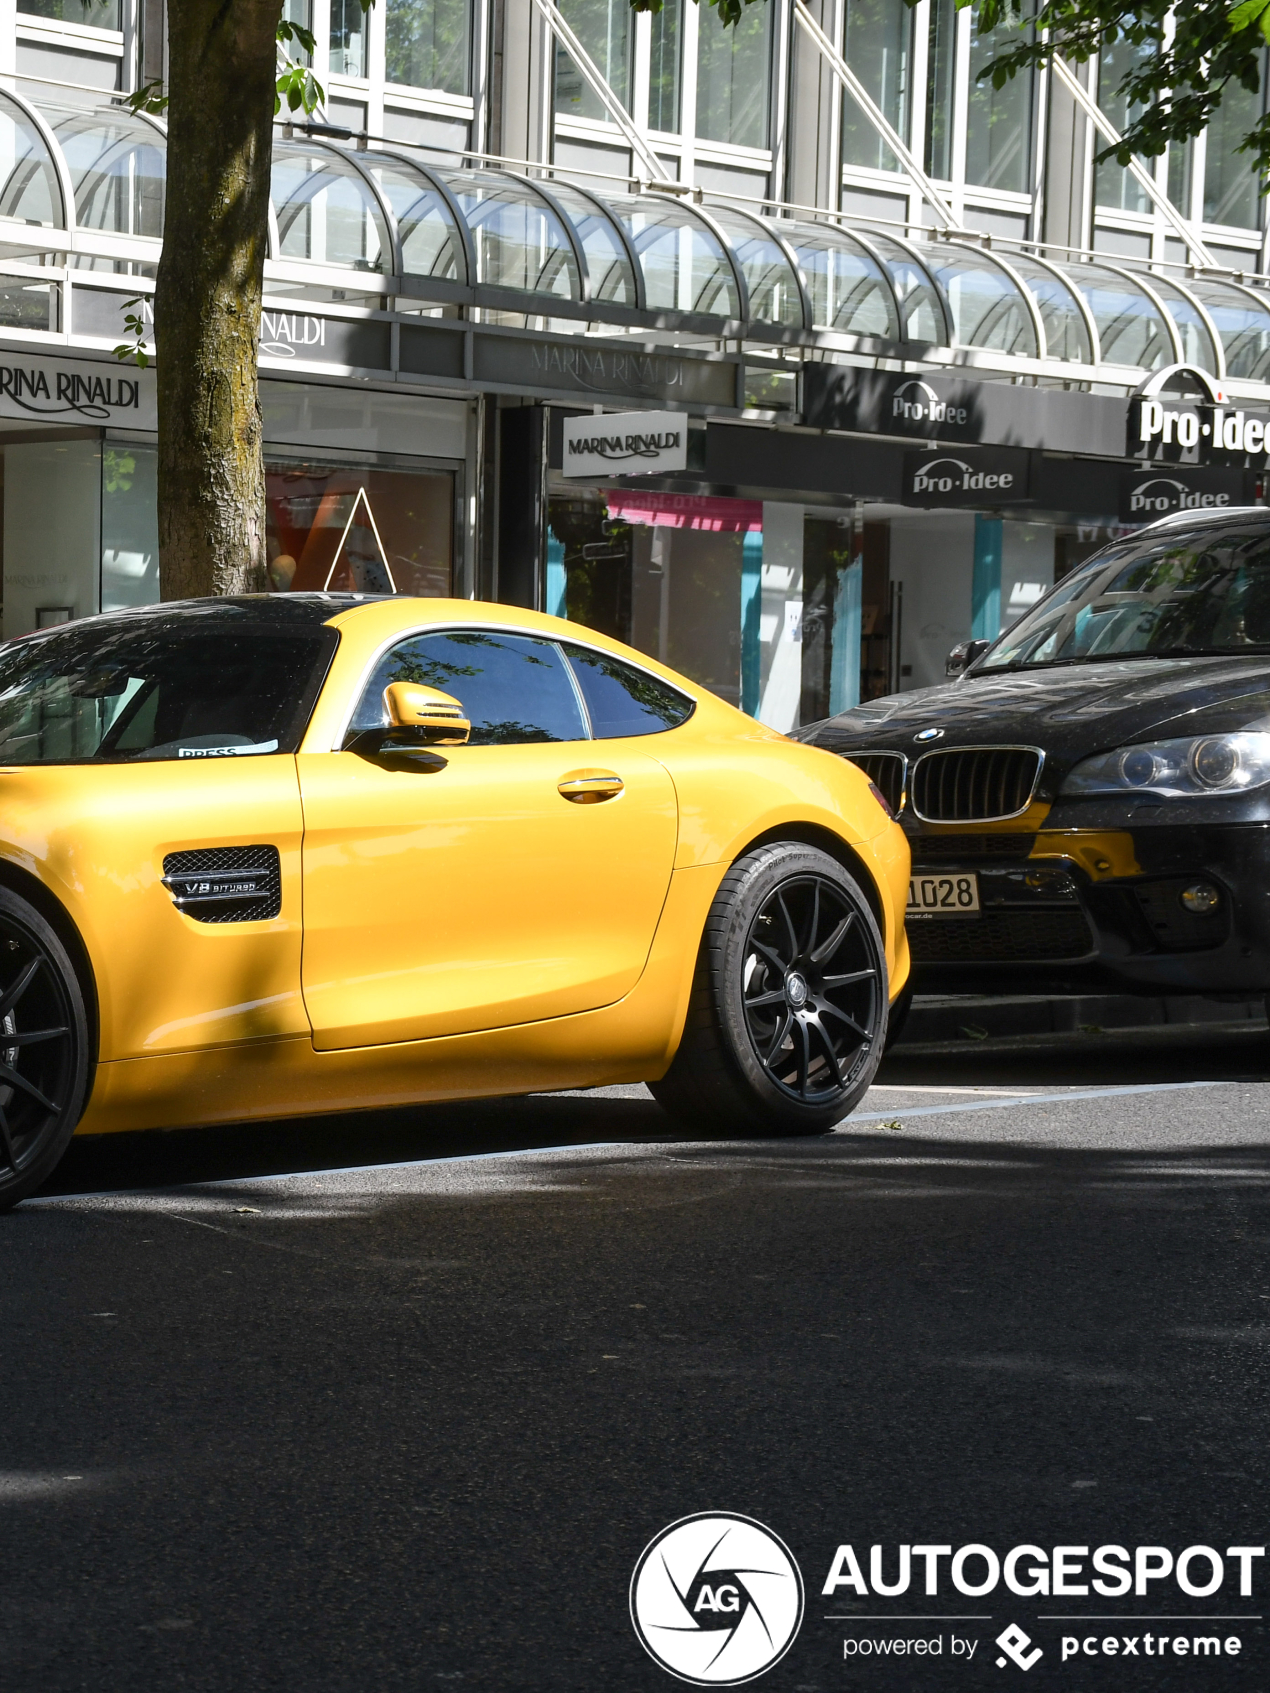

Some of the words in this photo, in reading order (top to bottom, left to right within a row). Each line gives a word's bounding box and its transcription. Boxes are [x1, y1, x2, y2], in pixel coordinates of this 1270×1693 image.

[260, 310, 325, 352] NALDI
[56, 372, 139, 417] RINALDI
[568, 436, 624, 458] MARINA
[625, 432, 680, 456] RINALDI
[185, 883, 210, 894] V8
[213, 883, 255, 893] BITURBO
[907, 878, 973, 907] 1028
